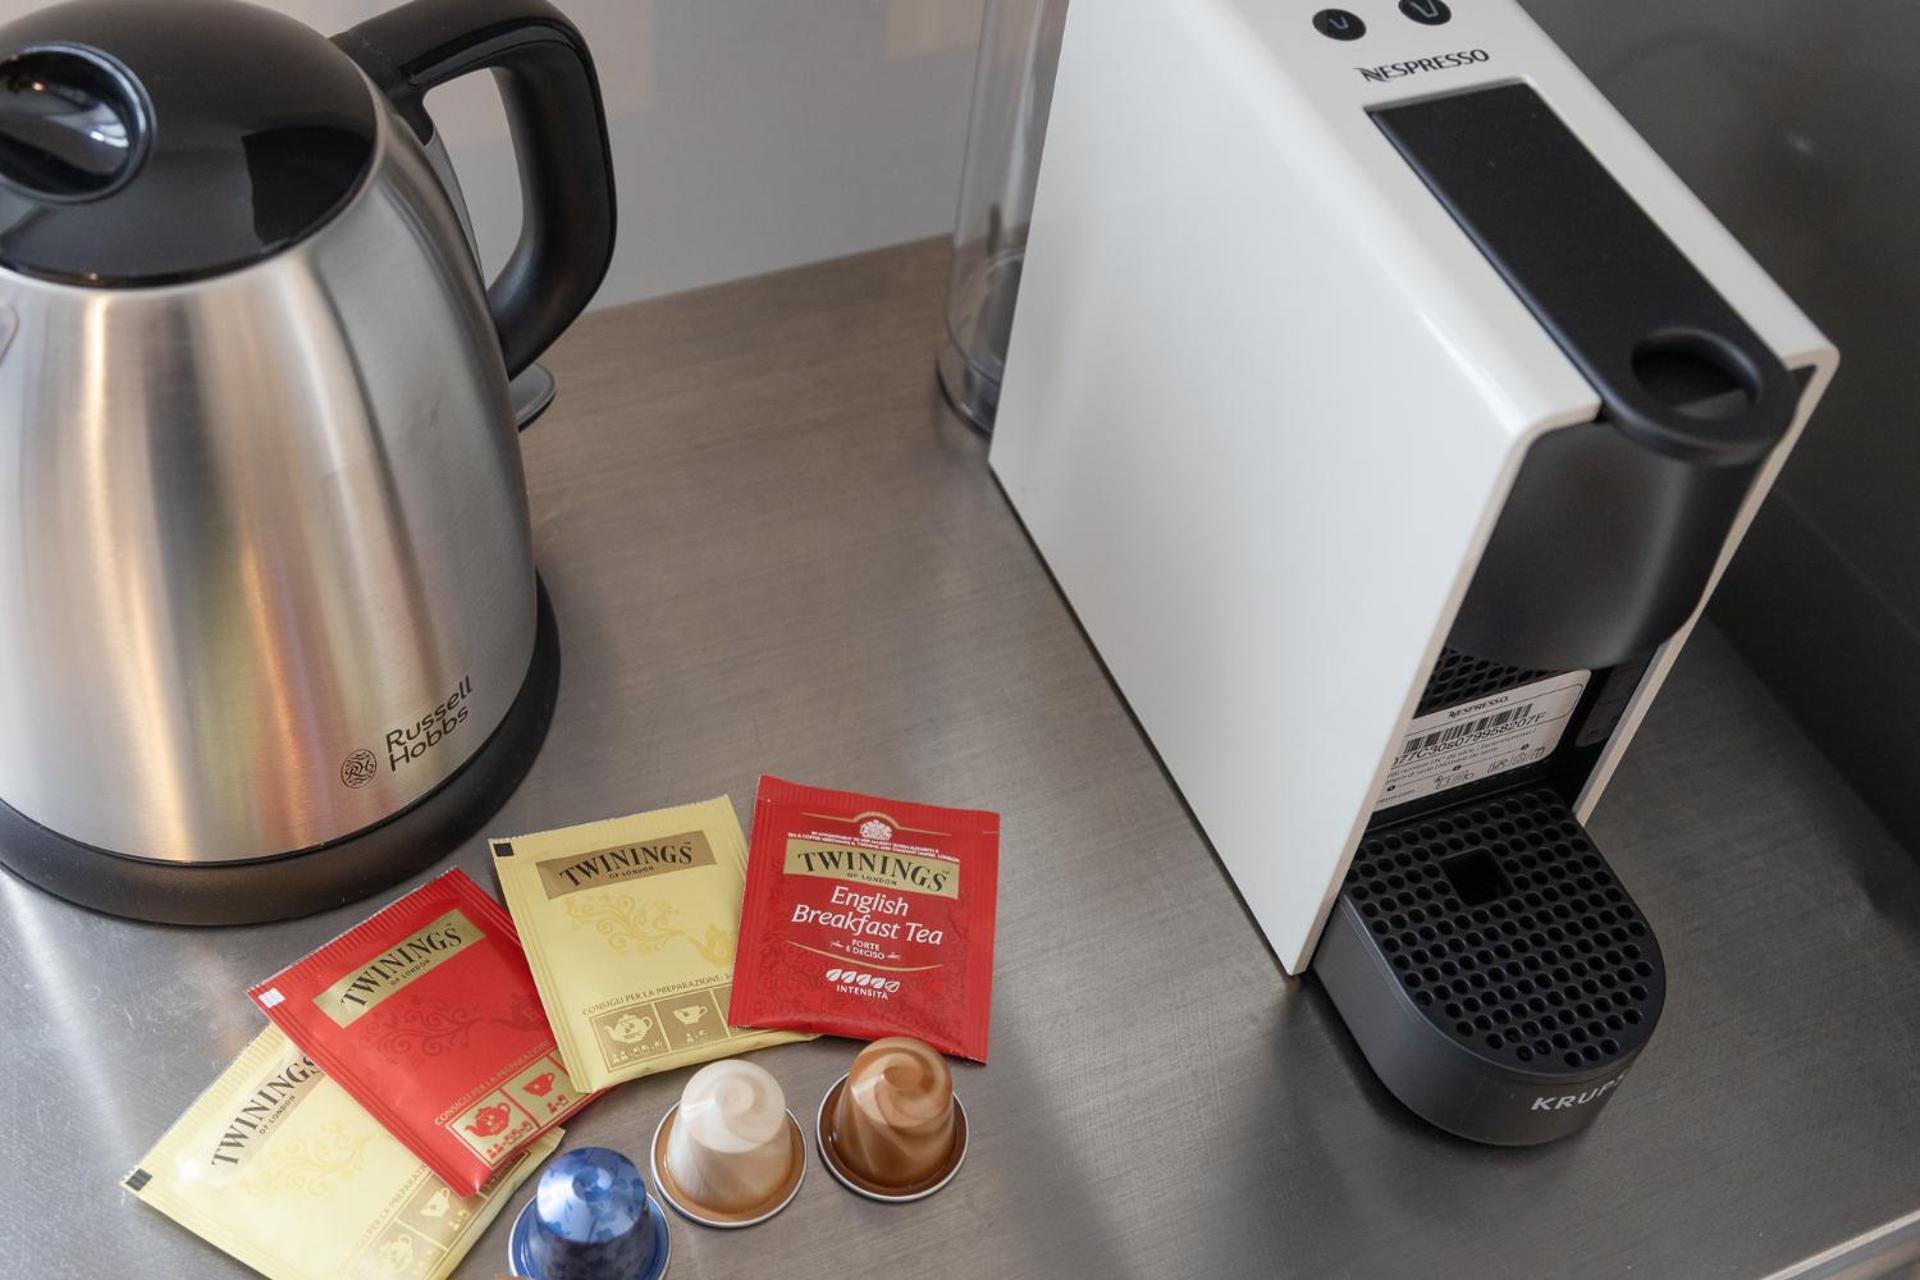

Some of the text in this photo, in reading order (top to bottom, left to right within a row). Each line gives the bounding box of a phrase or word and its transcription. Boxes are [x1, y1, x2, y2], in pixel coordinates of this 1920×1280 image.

[1352, 48, 1490, 82] NESPRESSO
[385, 674, 473, 753] Russell
[389, 705, 469, 773] Hobbs
[559, 843, 693, 887] TWININGS
[622, 865, 655, 878] LONDON
[798, 850, 948, 893] TWININGS
[846, 871, 898, 887] OF LONDON
[830, 885, 909, 917] English
[791, 904, 944, 946] Breakfast Tea
[852, 939, 880, 951] FORTE
[852, 946, 886, 960] DECISO
[340, 927, 462, 1007] TWININGS
[401, 959, 431, 980] LONDON
[836, 984, 889, 1001] INTENSITÀ
[211, 1056, 321, 1166] TWININGS
[258, 1094, 297, 1136] OF LONDON
